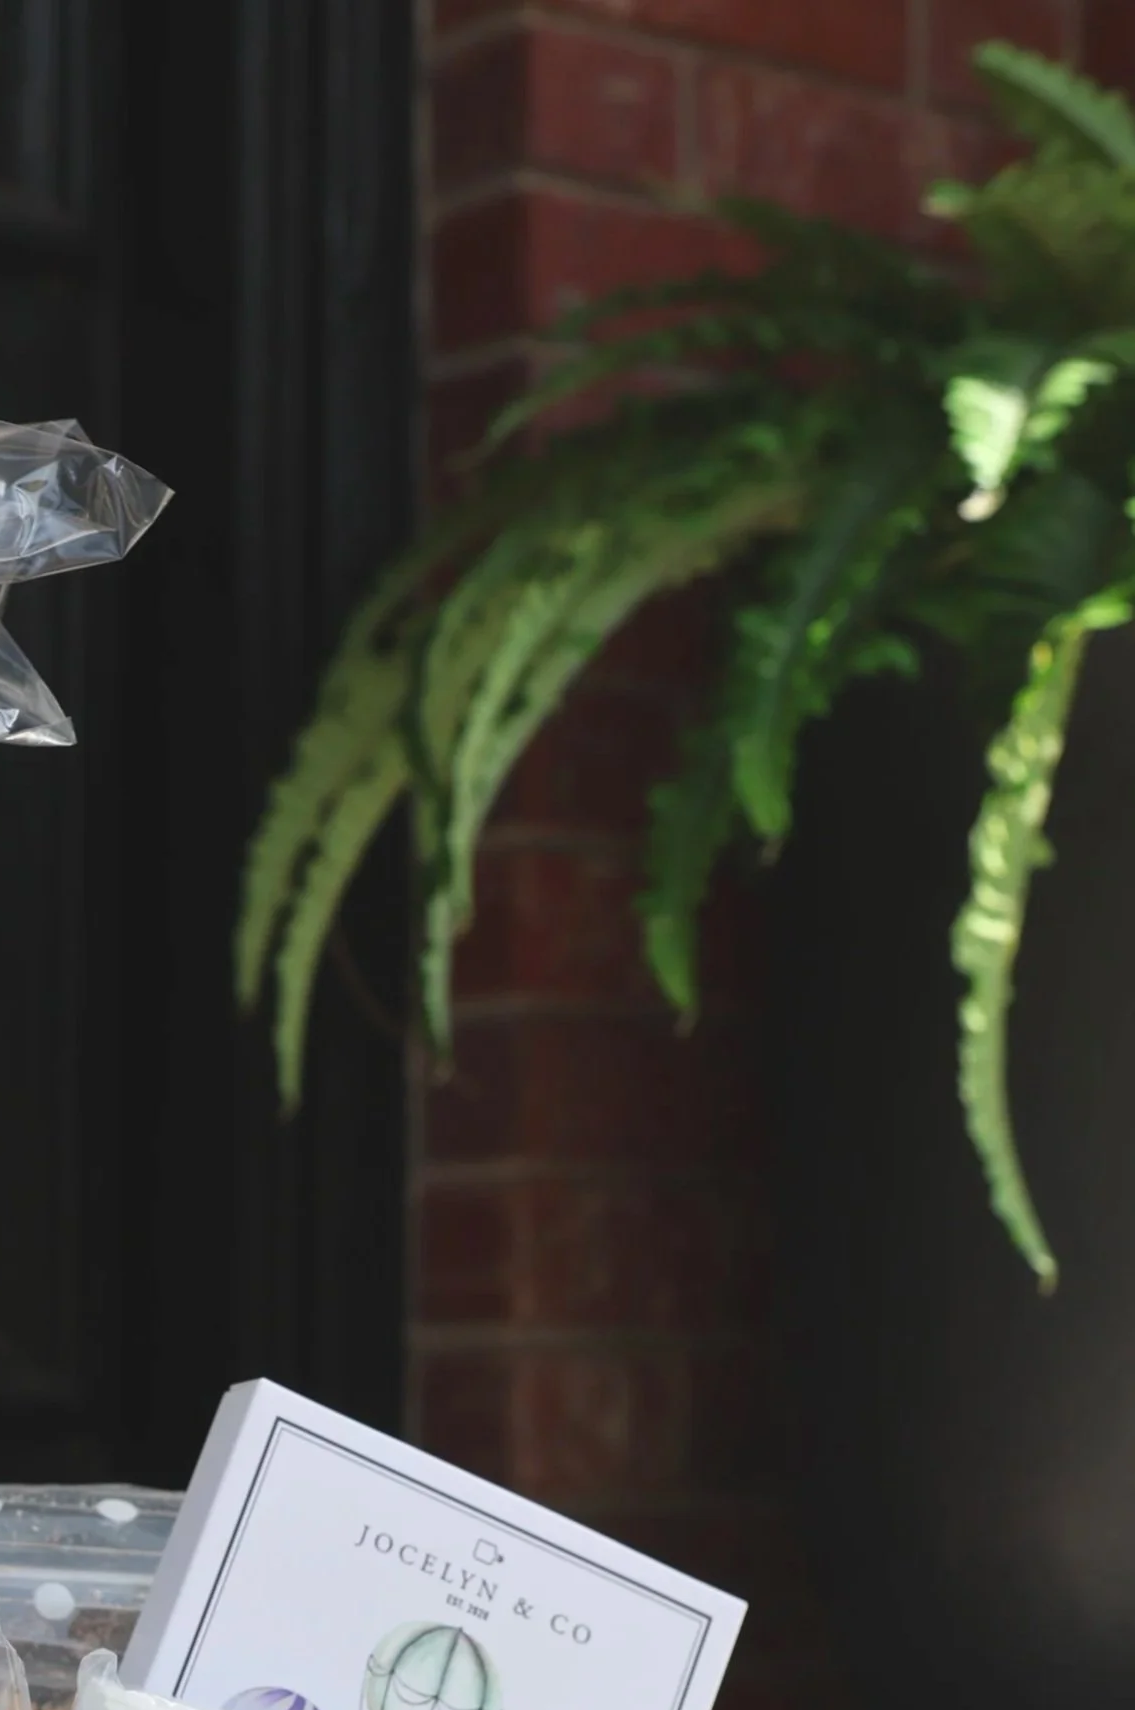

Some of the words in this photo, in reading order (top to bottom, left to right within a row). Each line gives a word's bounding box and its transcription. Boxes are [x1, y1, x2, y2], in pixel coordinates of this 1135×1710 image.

[354, 1525, 499, 1602] JOCELYN
[513, 1597, 534, 1619] &
[549, 1613, 593, 1645] CO
